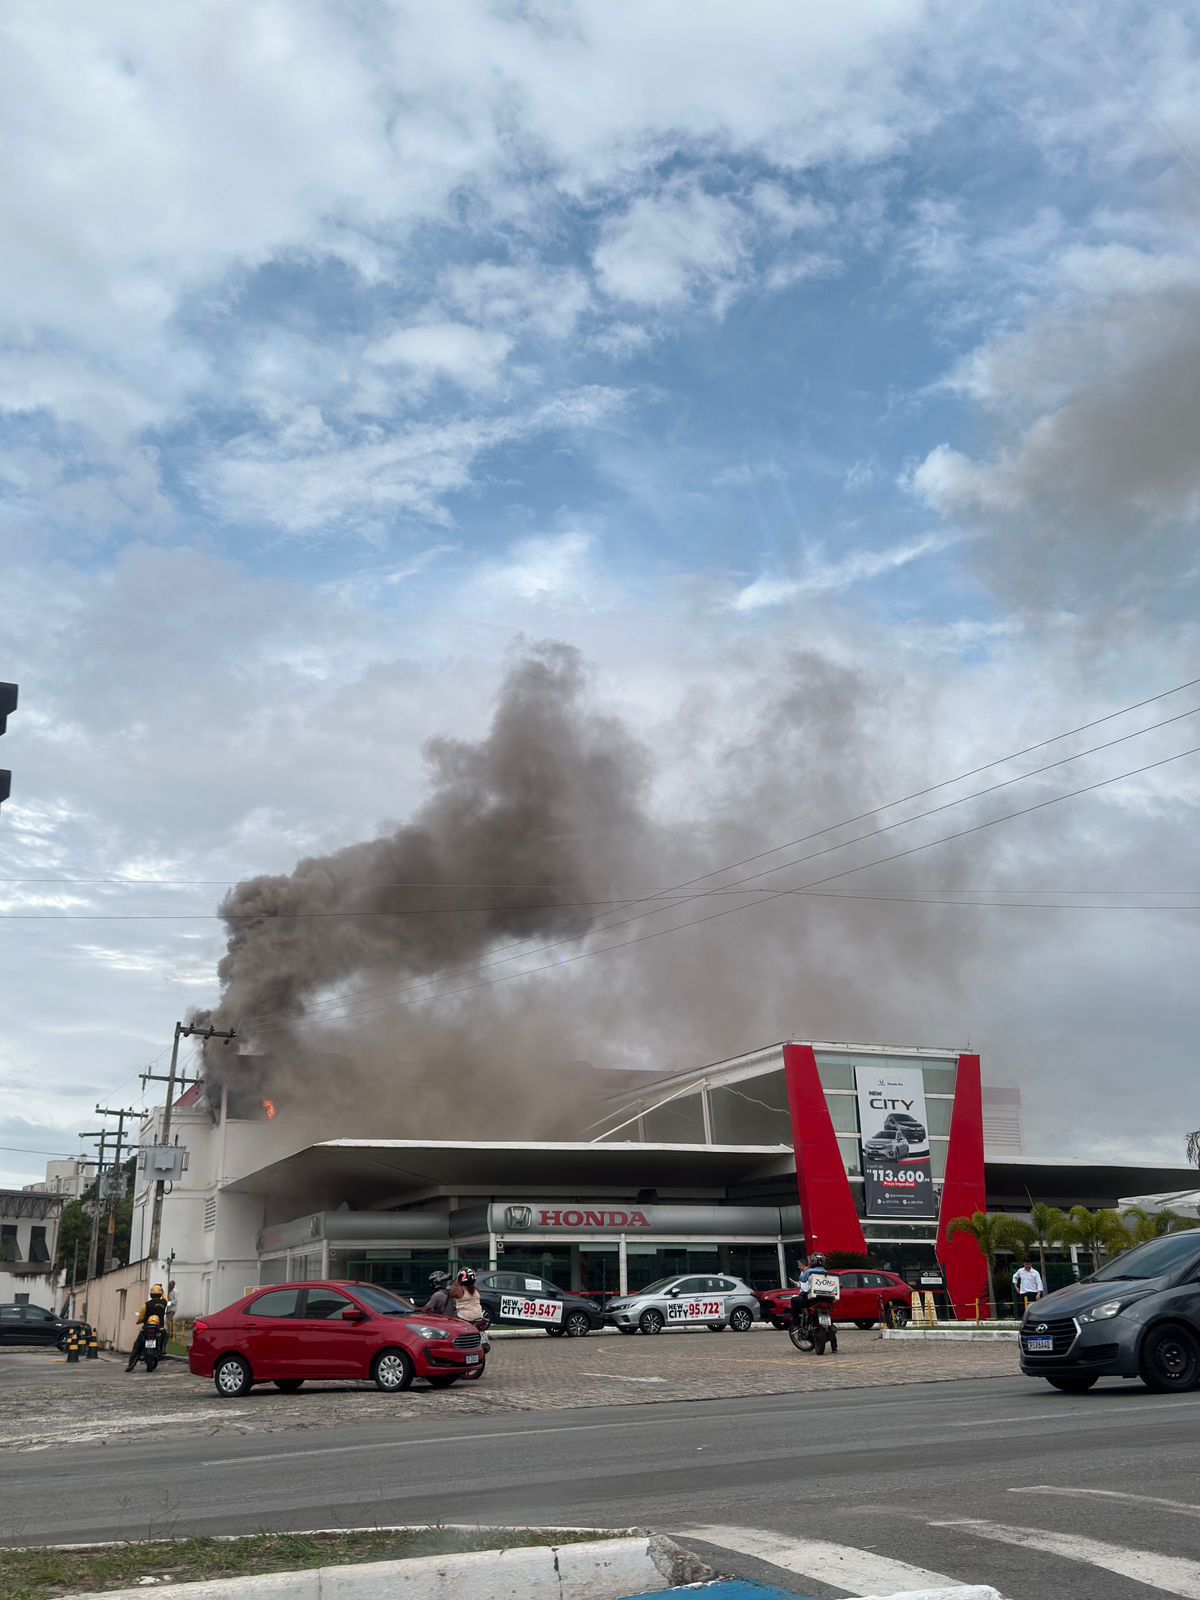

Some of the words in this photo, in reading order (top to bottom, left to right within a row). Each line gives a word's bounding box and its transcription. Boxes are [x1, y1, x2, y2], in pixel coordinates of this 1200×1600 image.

[869, 1098, 914, 1111] CITY
[872, 1169, 925, 1183] 113.600
[538, 1210, 651, 1227] HONDA
[502, 1298, 518, 1306] NEW
[501, 1306, 523, 1316] CITY
[523, 1302, 557, 1317] 99.547
[668, 1309, 688, 1319] CITY
[688, 1302, 720, 1316] 95.722
